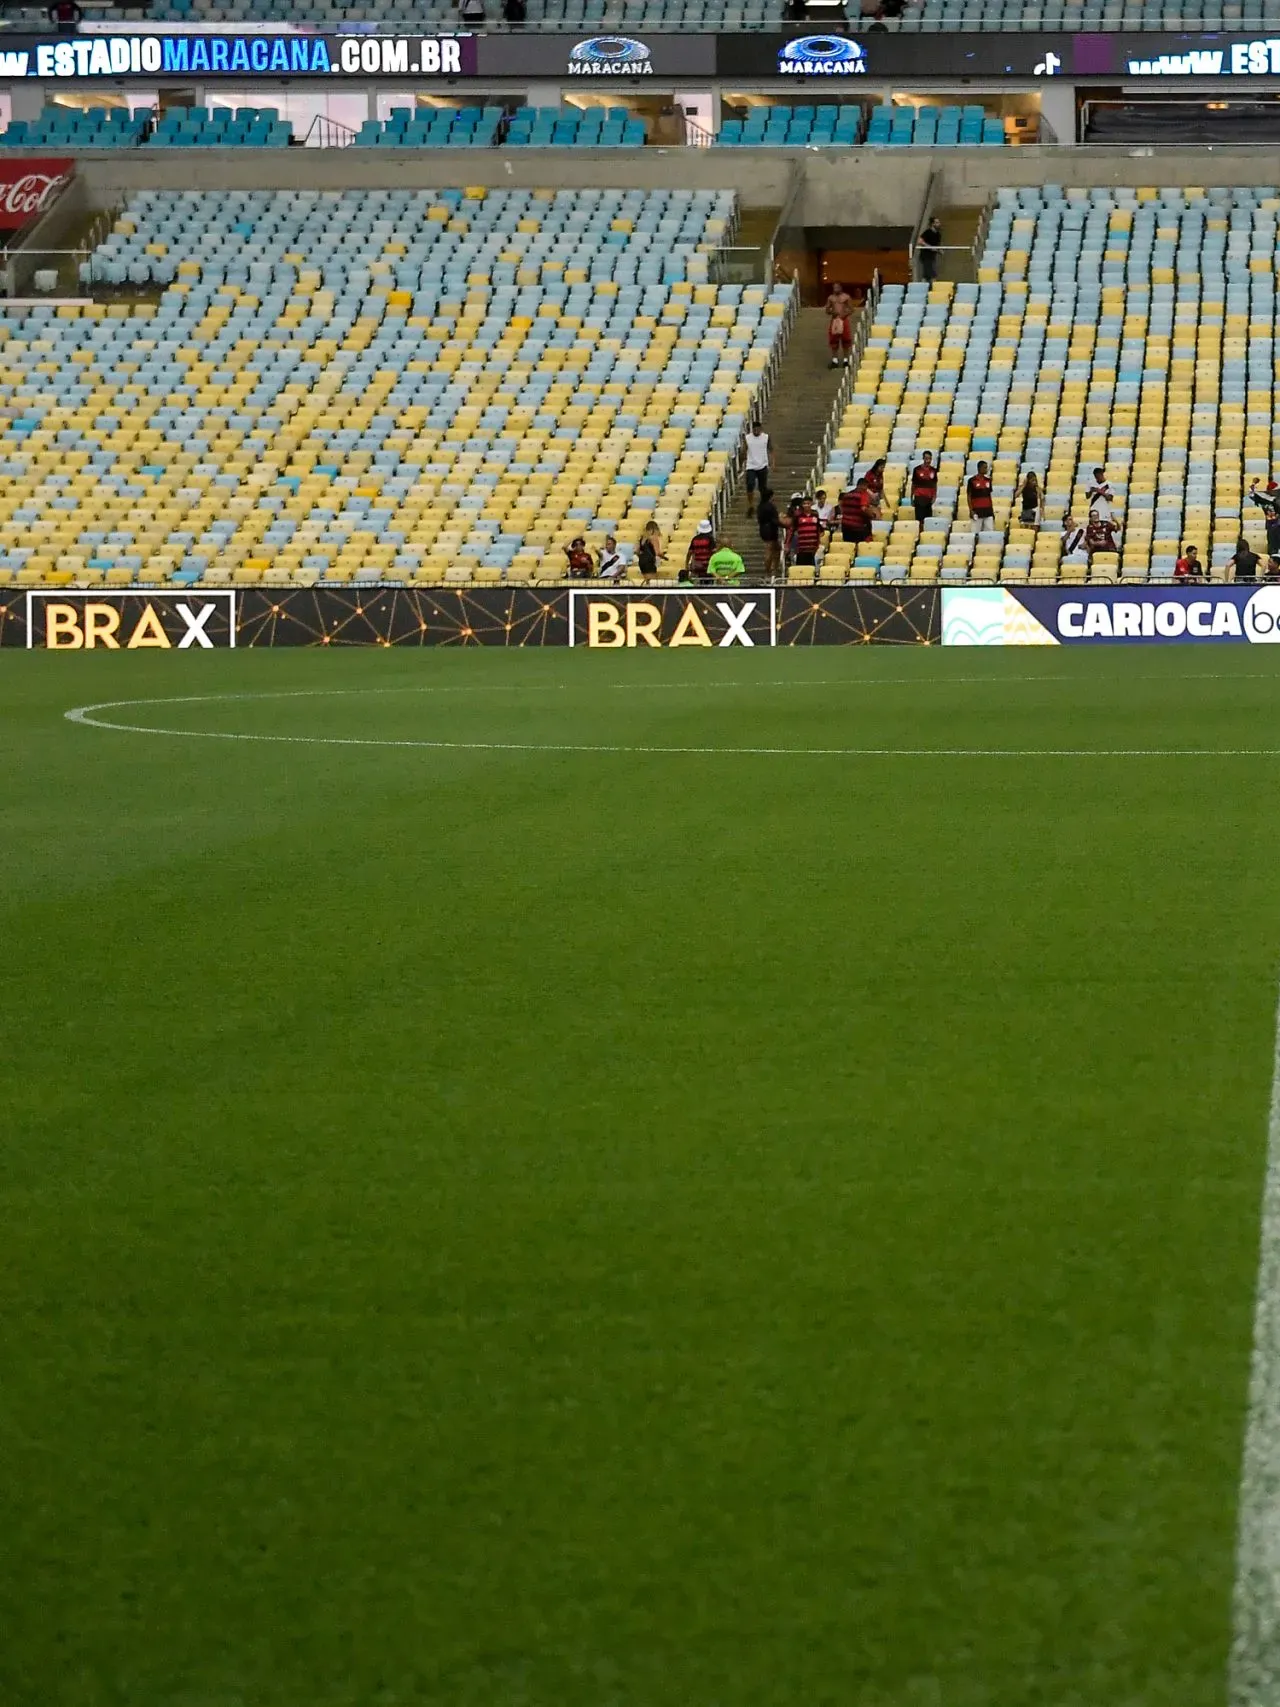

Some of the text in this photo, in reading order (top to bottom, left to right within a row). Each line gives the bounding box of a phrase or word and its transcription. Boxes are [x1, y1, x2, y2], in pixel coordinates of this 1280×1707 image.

[46, 603, 216, 649] BRAX
[588, 602, 757, 647] BRAX
[1057, 602, 1242, 637] CARIOCA
